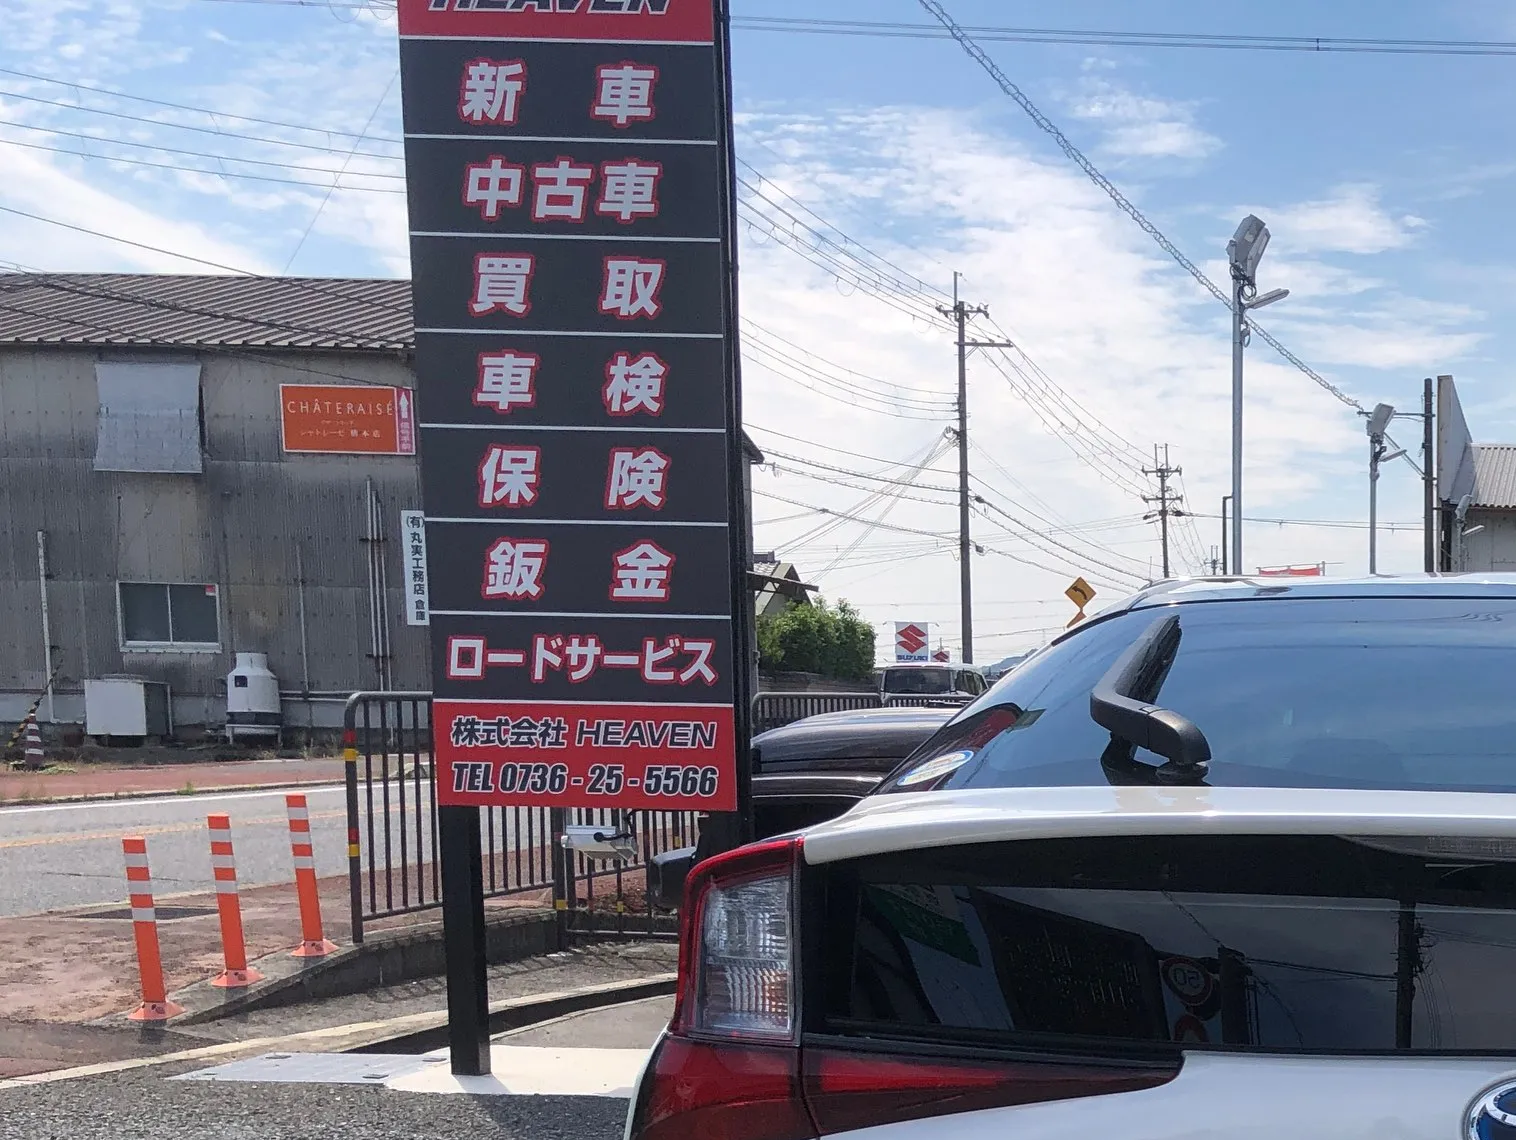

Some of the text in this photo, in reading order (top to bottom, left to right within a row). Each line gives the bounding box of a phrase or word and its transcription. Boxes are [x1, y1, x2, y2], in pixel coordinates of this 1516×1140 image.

[461, 60, 657, 125] 新車
[465, 157, 661, 222] 中古車
[470, 255, 664, 318] 買取
[287, 399, 394, 416] CHÂTERAISÉ
[475, 351, 667, 414] 車検
[480, 446, 670, 508] 保険
[484, 539, 673, 600] 鈑金
[448, 635, 718, 686] ロードサービス
[451, 716, 717, 749] 株式会社 HEAVEN
[452, 762, 494, 792] TEL
